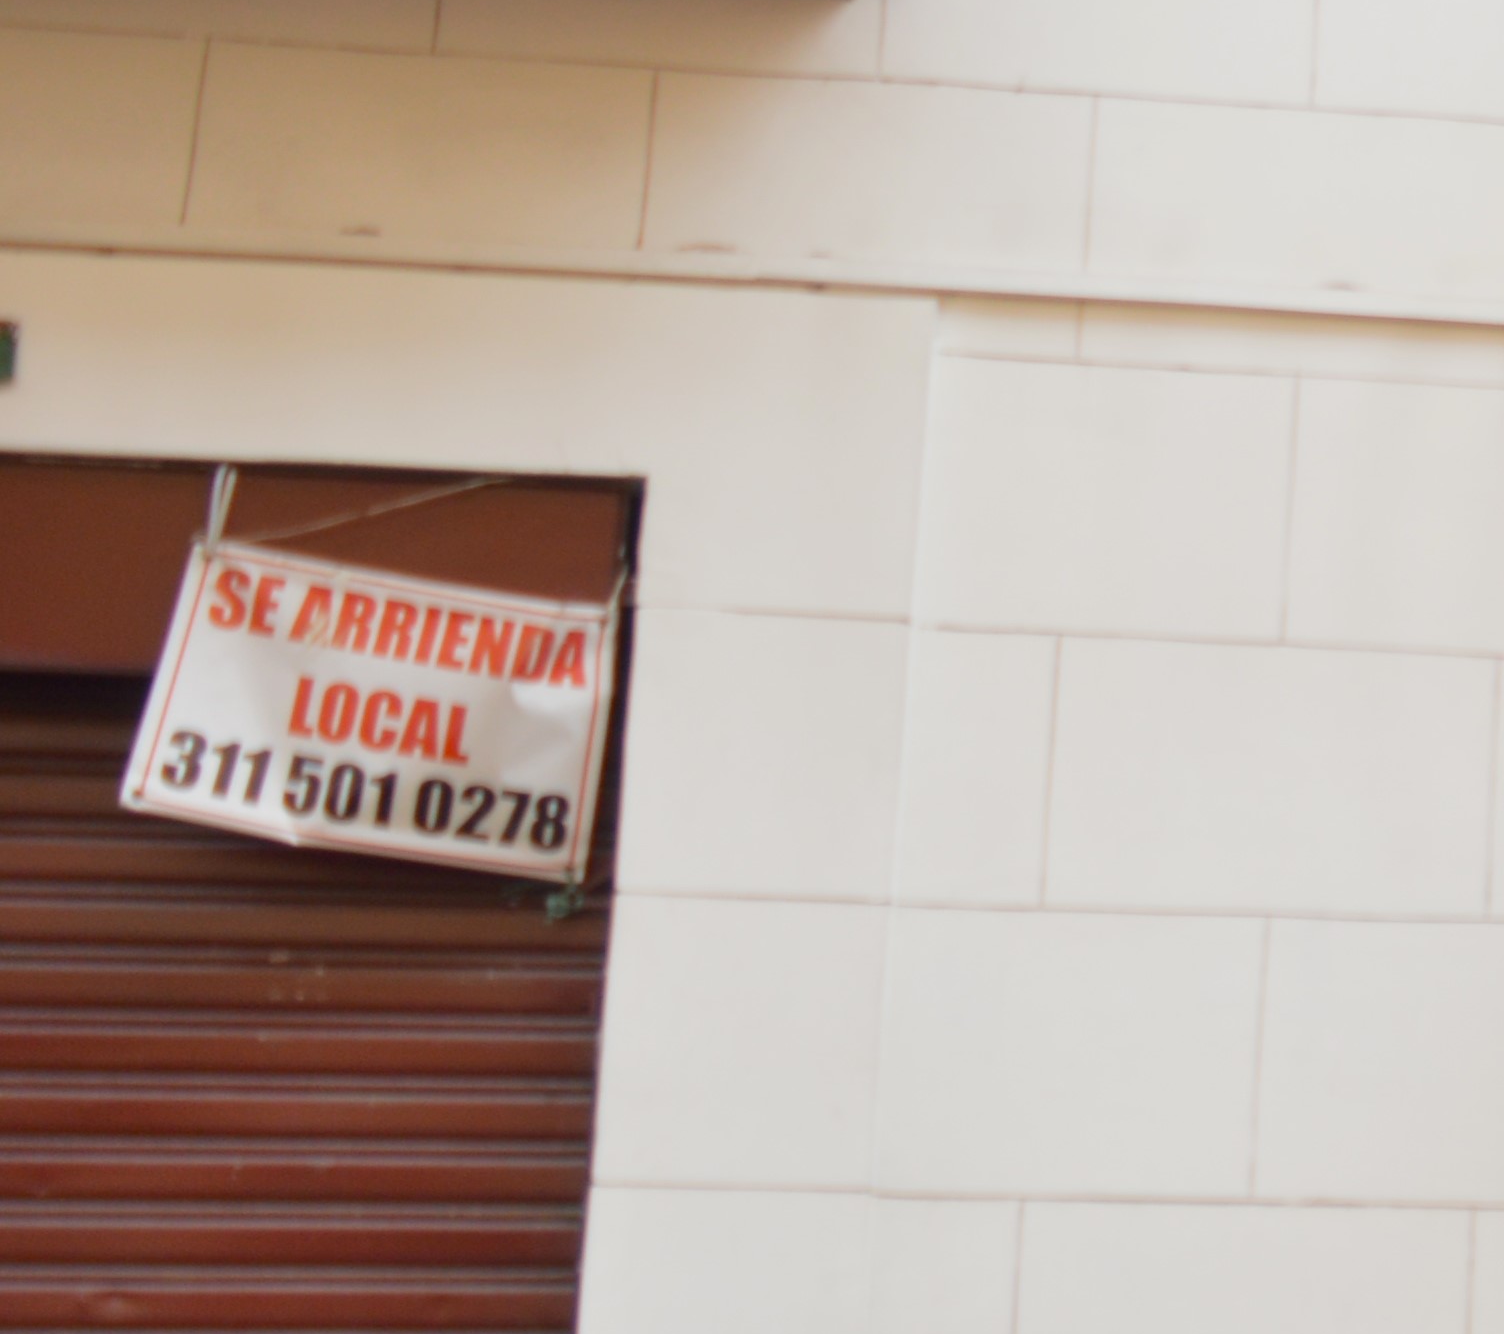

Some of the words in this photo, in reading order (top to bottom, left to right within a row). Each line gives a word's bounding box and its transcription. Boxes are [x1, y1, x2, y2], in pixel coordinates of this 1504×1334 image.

[208, 567, 286, 638] SE
[287, 584, 588, 689] ARRIENDA
[287, 675, 469, 765] LOCAL
[160, 729, 273, 807] 311
[282, 755, 398, 831] 501
[413, 777, 569, 852] 0278
